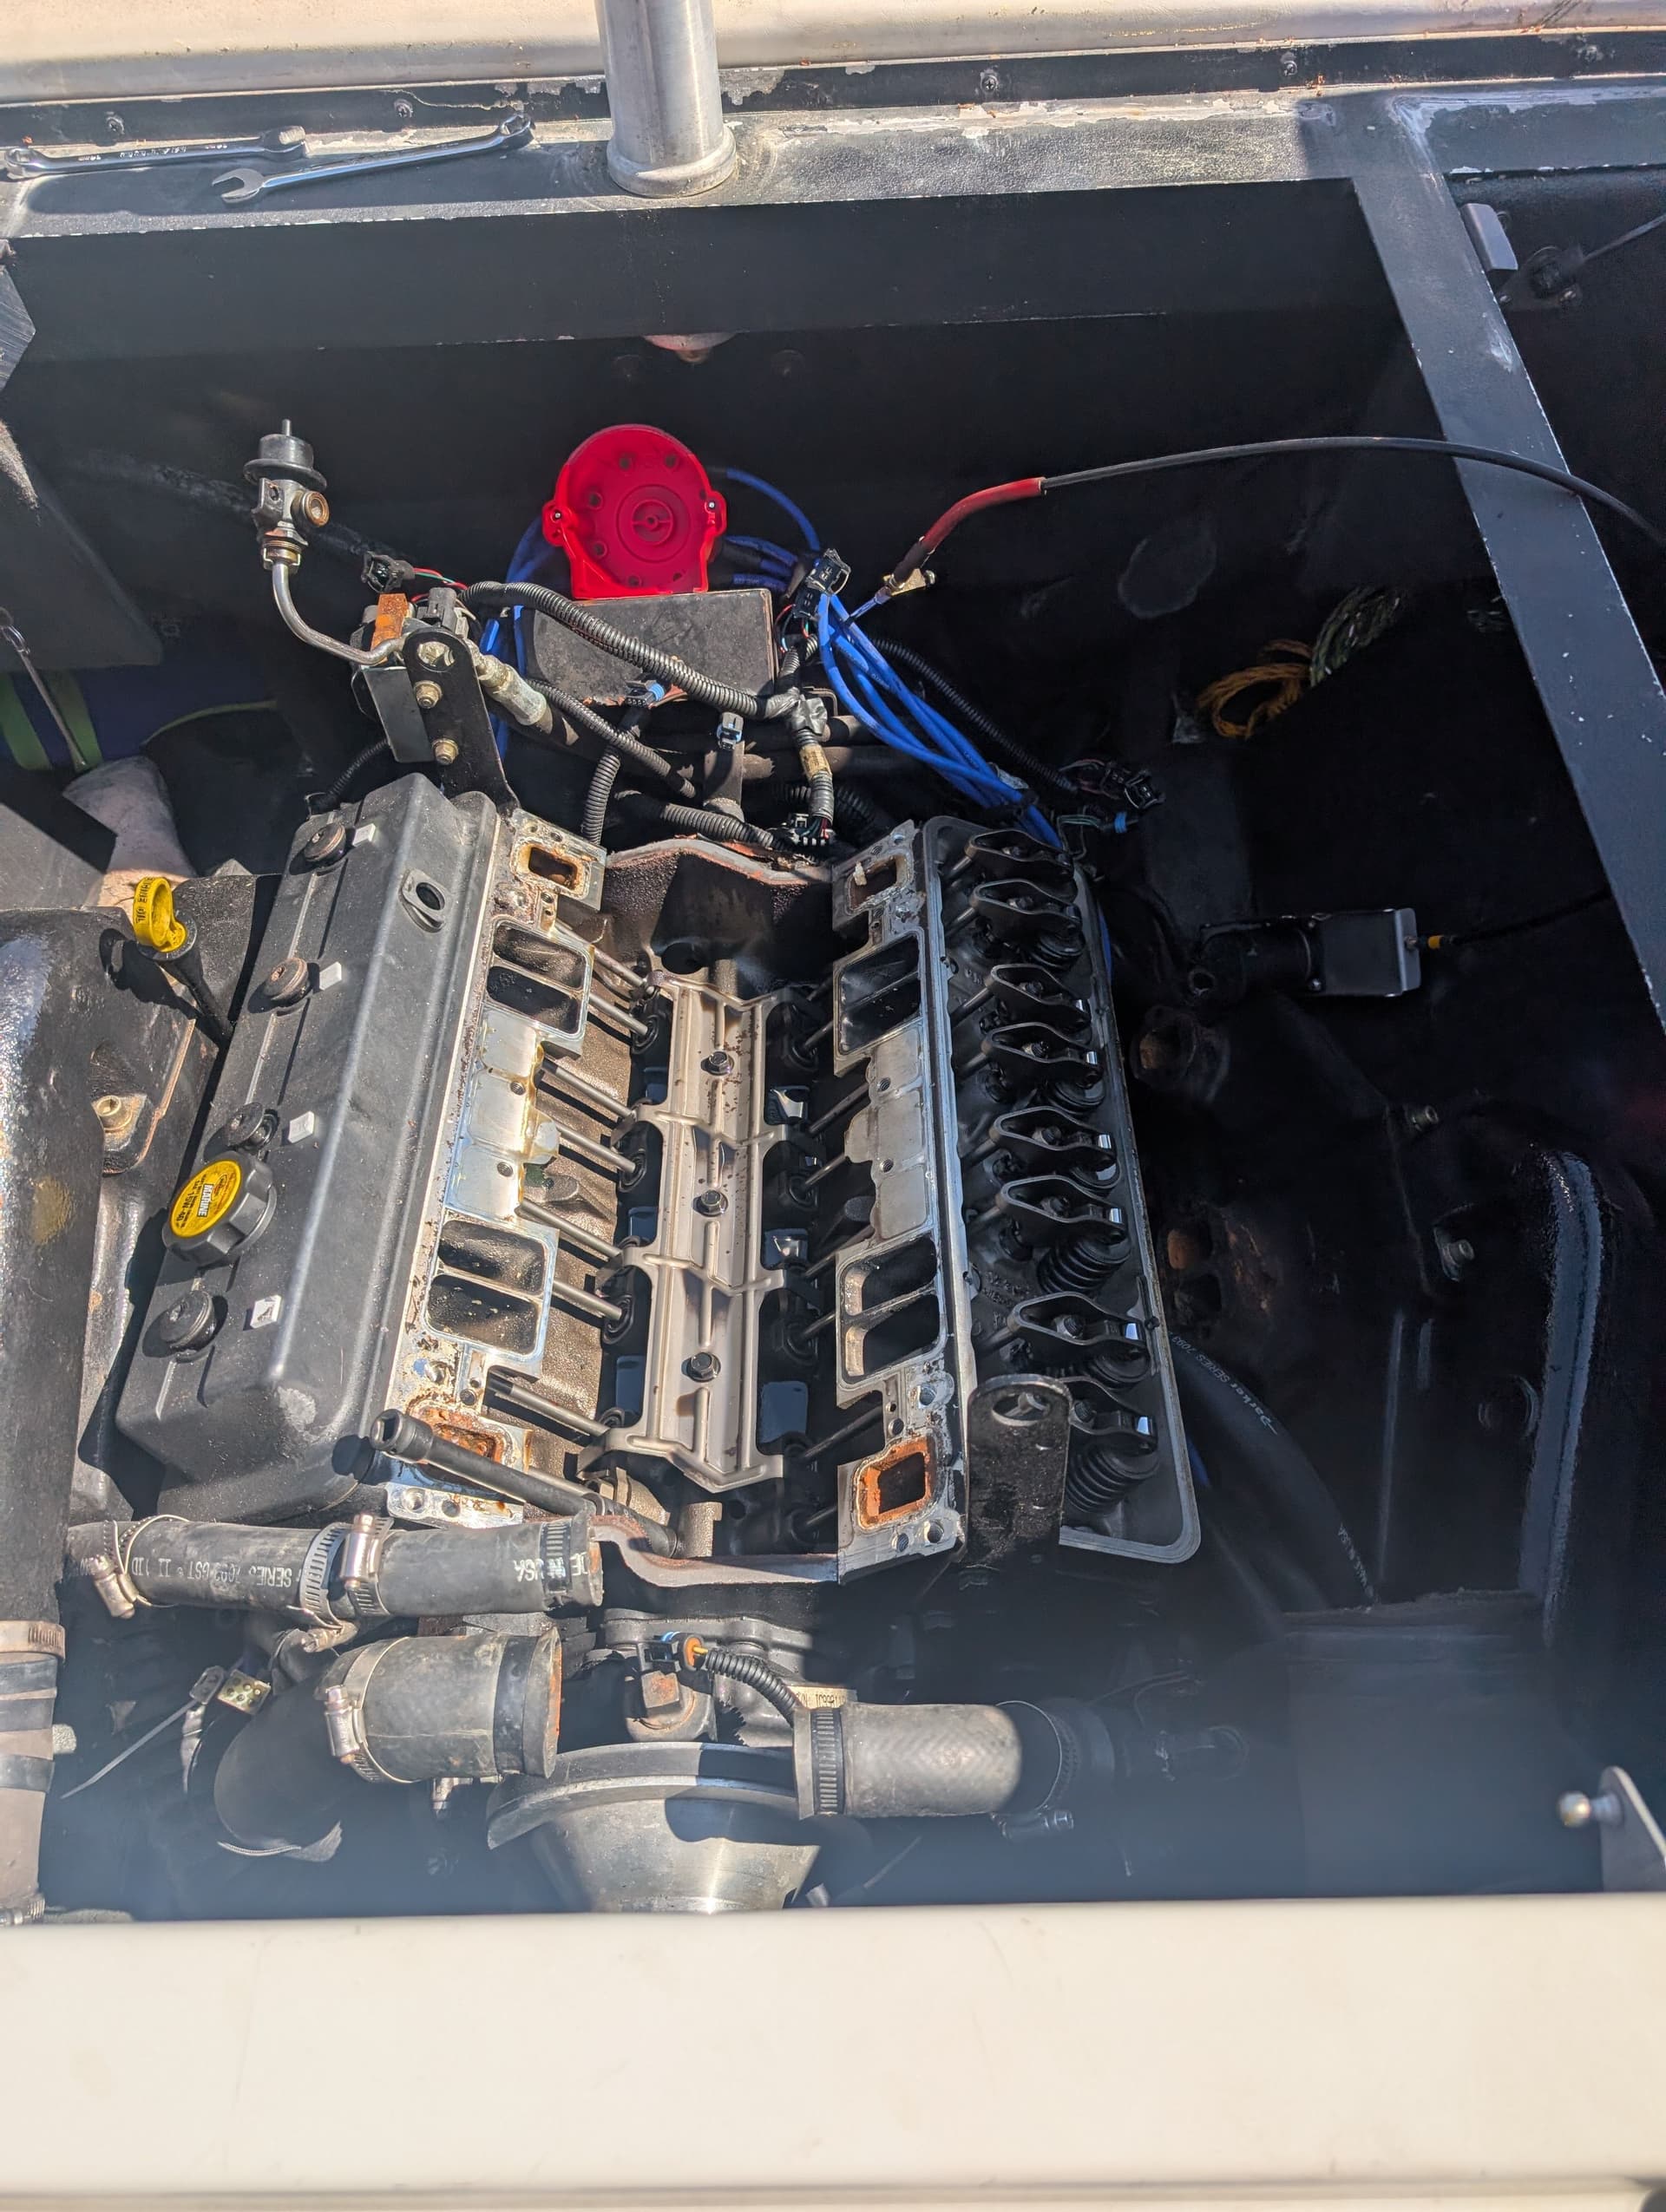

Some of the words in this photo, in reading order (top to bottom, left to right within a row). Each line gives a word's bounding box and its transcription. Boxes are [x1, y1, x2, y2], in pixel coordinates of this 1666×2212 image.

[136, 907, 147, 924] OIL
[198, 1184, 213, 1216] MARINE
[1171, 1336, 1197, 1353] 7093
[1196, 1353, 1230, 1383] SERIES
[1230, 1383, 1277, 1435] Parker
[513, 1558, 545, 1582] USA
